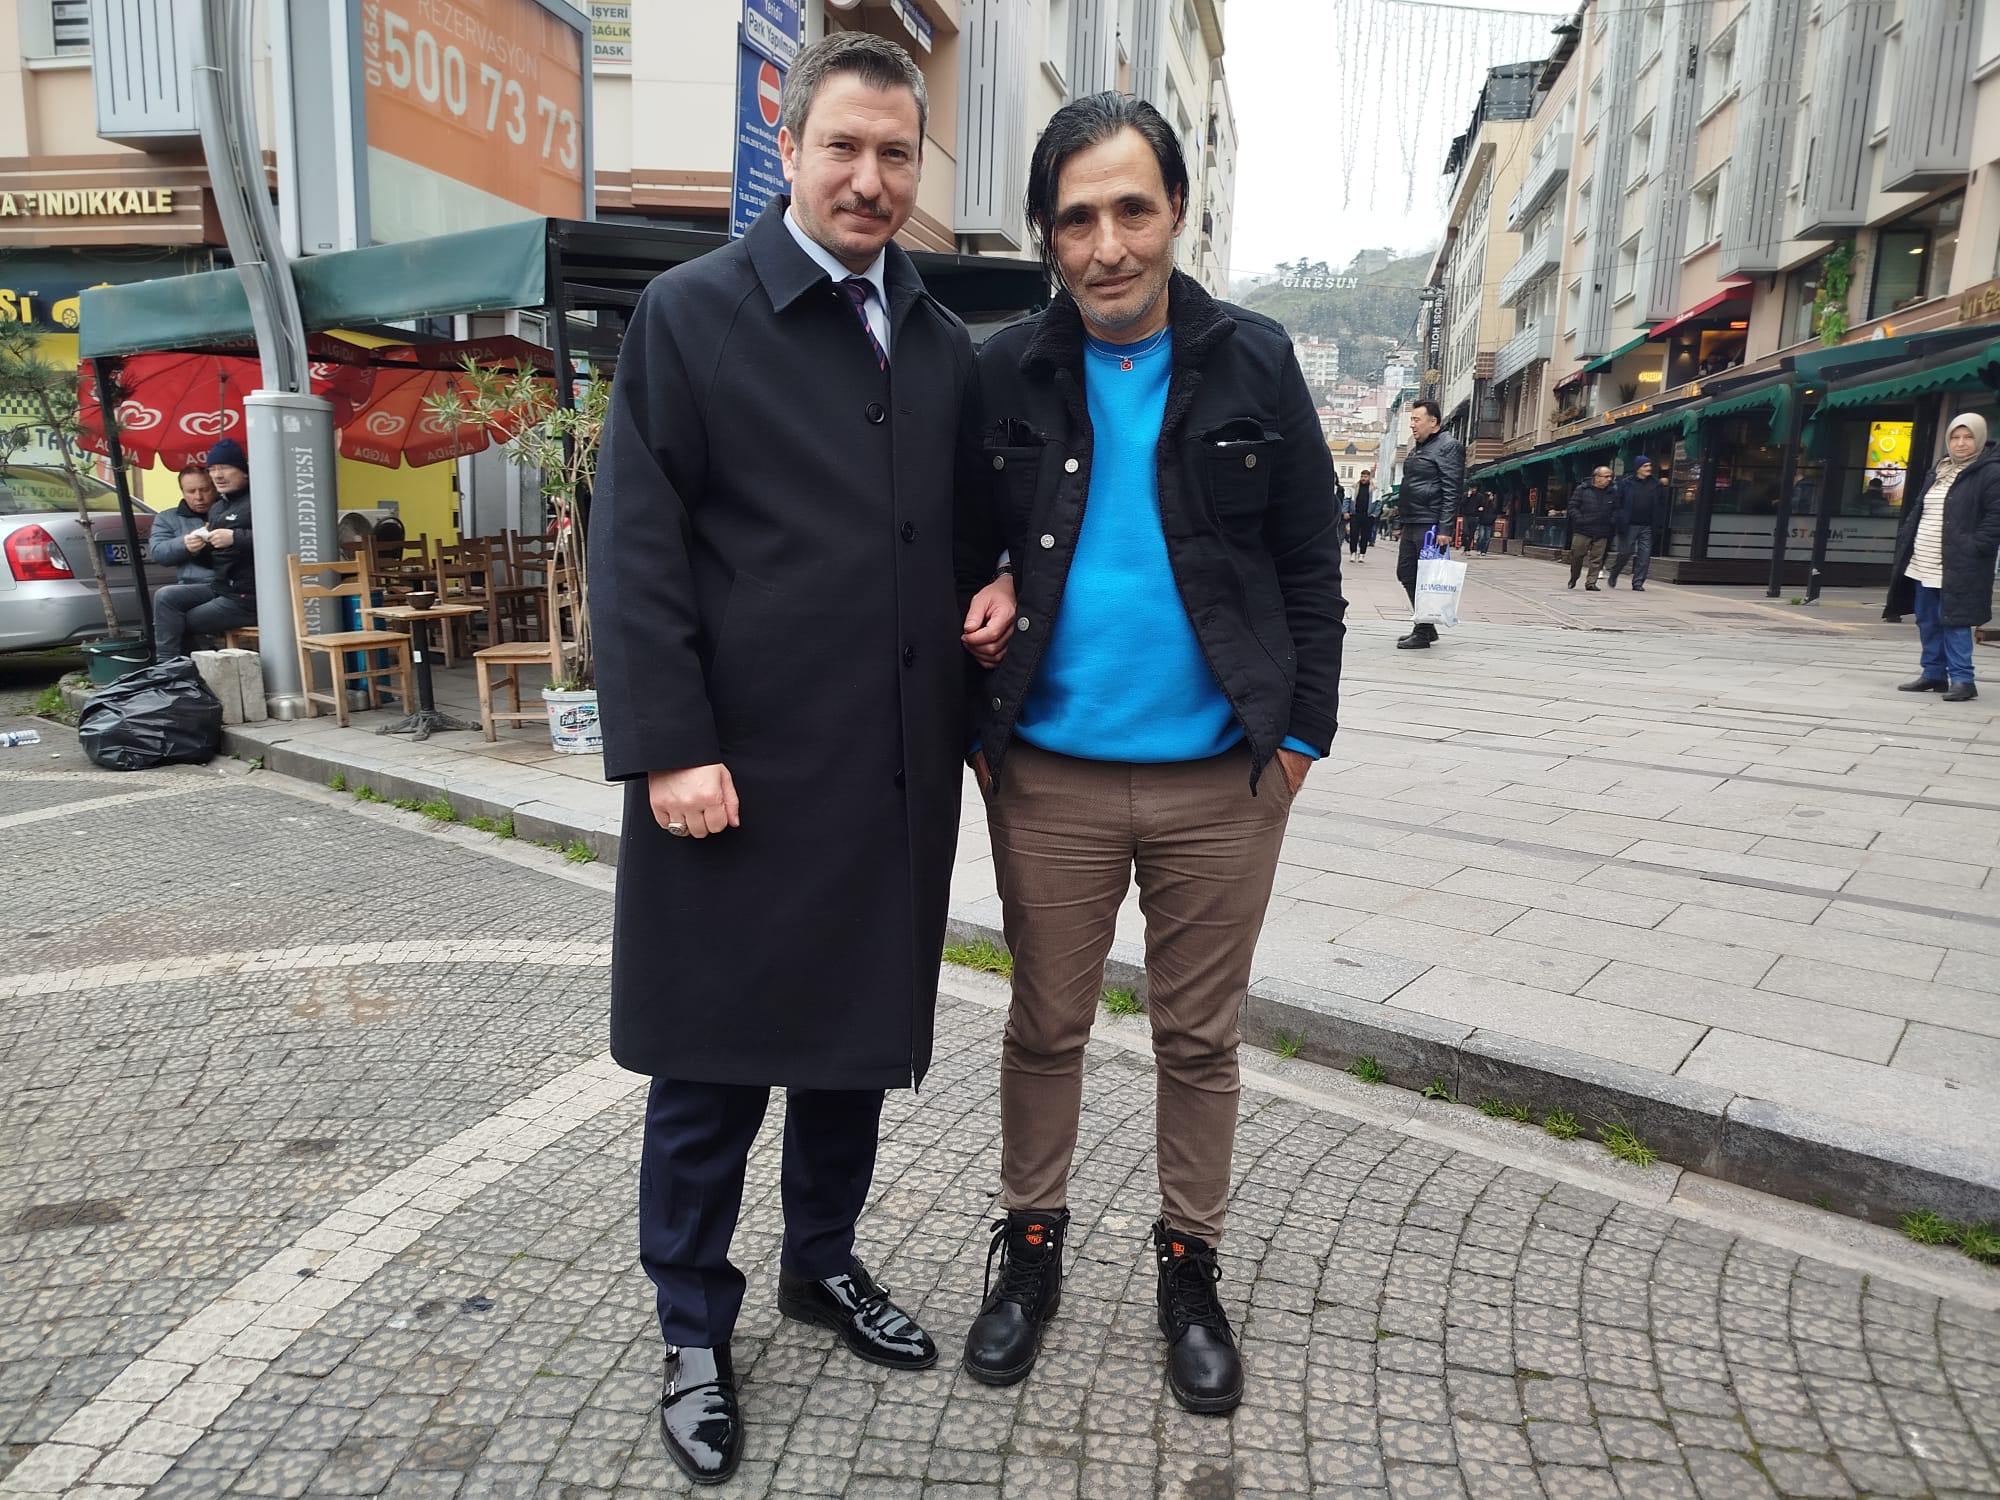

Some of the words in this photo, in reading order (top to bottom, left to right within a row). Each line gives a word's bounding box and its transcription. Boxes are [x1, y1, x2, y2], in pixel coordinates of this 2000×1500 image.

[417, 0, 538, 81] REZERVASYON
[592, 24, 632, 38] SAĞLIK
[748, 12, 766, 38] Park
[766, 24, 797, 58] Yapılmaz
[594, 45, 625, 56] DASK
[383, 8, 467, 117] 500
[480, 62, 527, 145] 73
[537, 95, 577, 170] 73
[1430, 326, 1441, 353] HOTEL
[291, 446, 318, 563] BELEDİYESİ
[112, 545, 128, 560] 28
